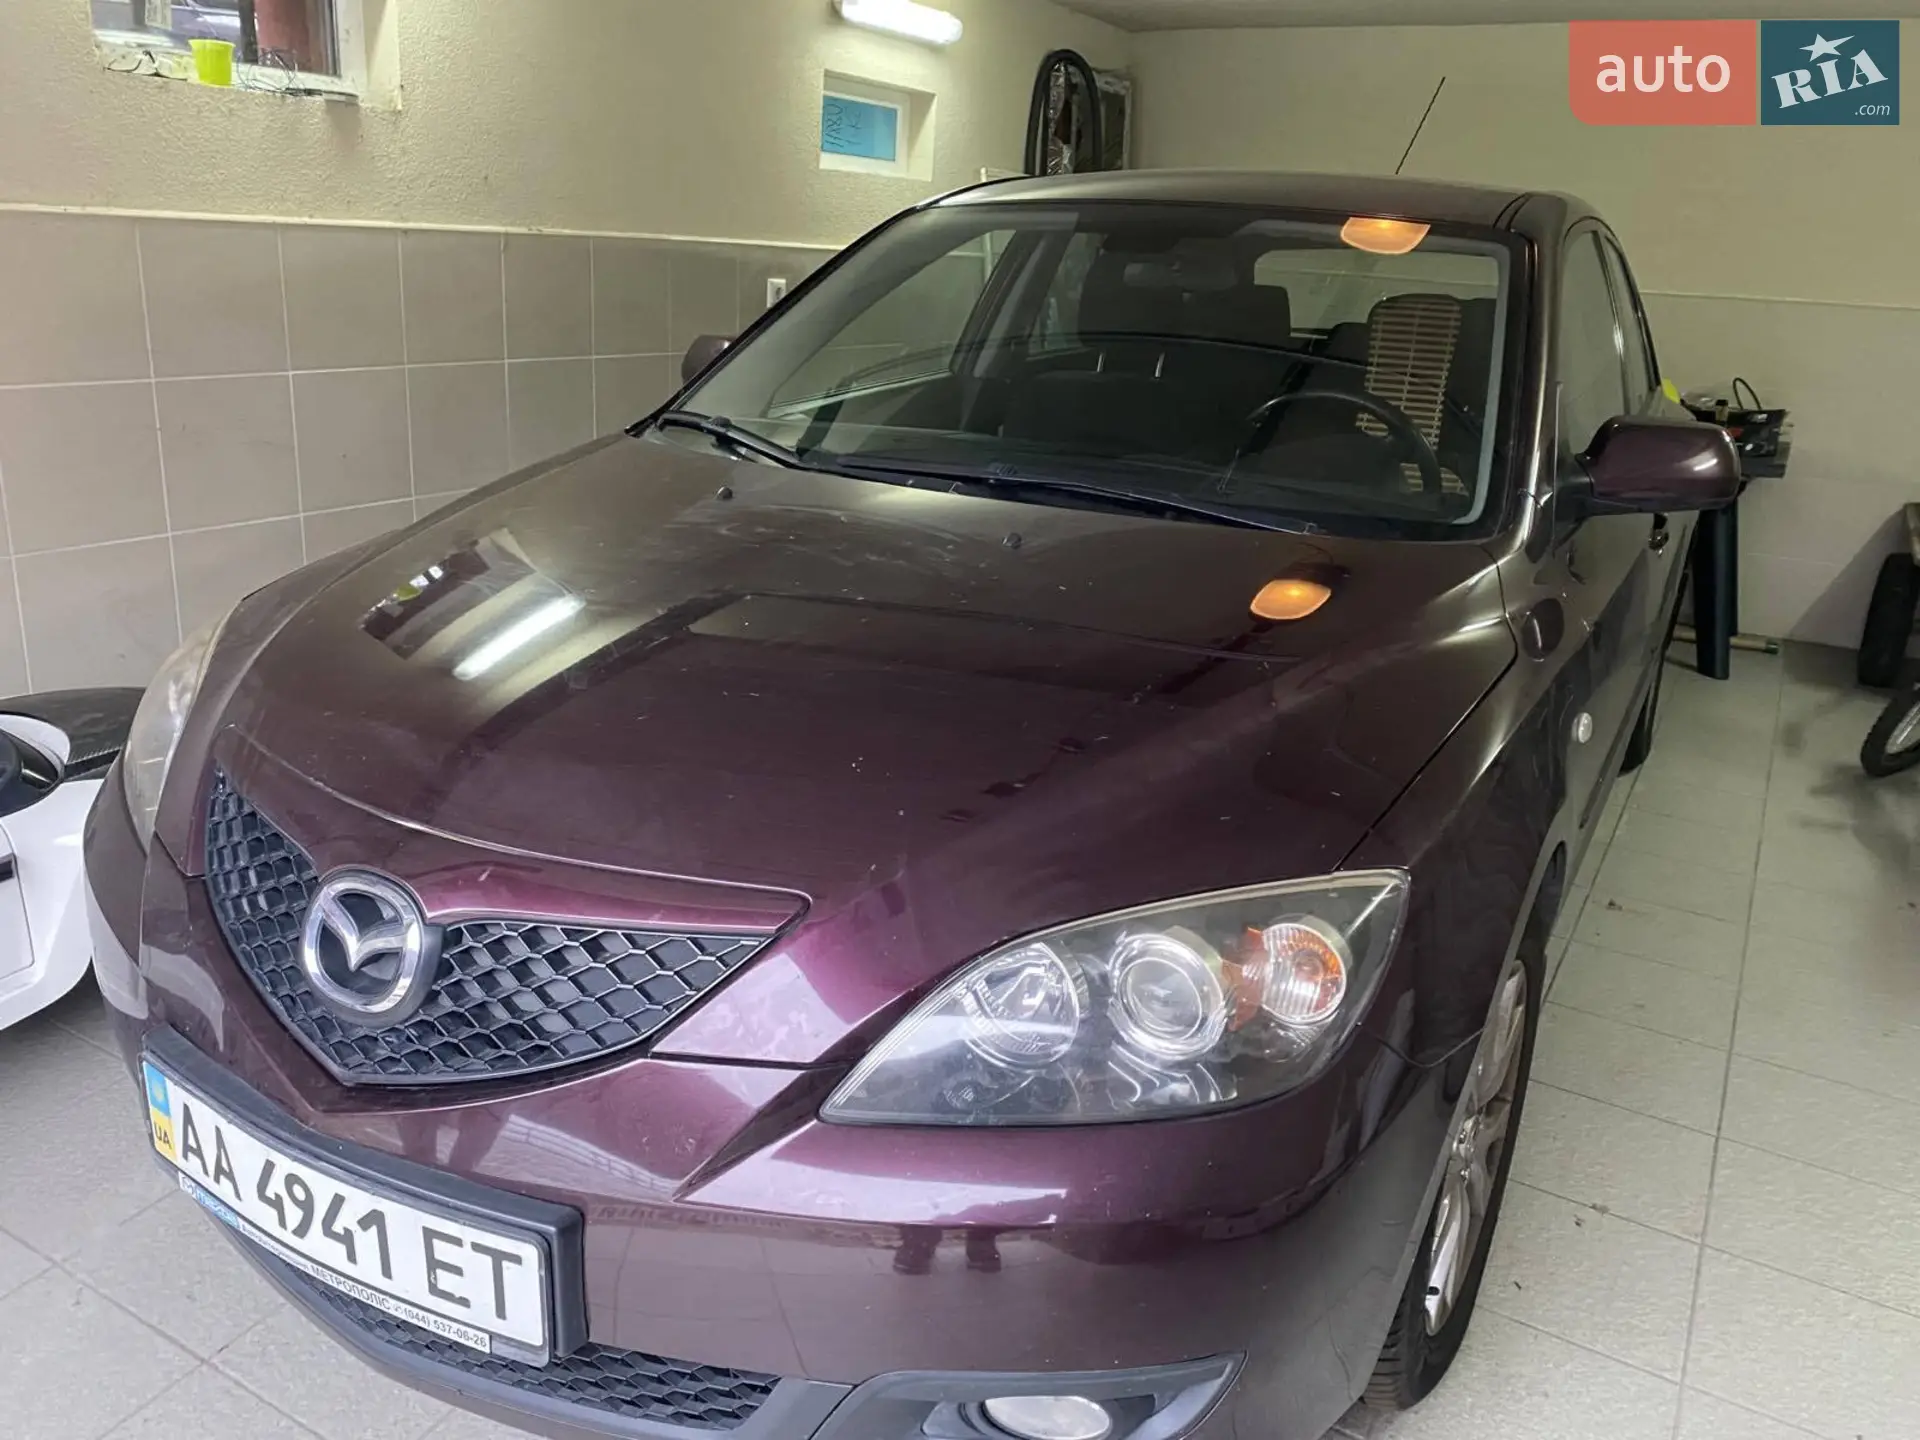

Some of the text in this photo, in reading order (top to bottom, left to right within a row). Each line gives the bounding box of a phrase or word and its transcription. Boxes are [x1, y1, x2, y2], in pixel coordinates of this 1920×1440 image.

[153, 1122, 172, 1149] UA
[181, 1102, 242, 1203] AA
[256, 1159, 393, 1281] 4941
[422, 1225, 523, 1320] ET
